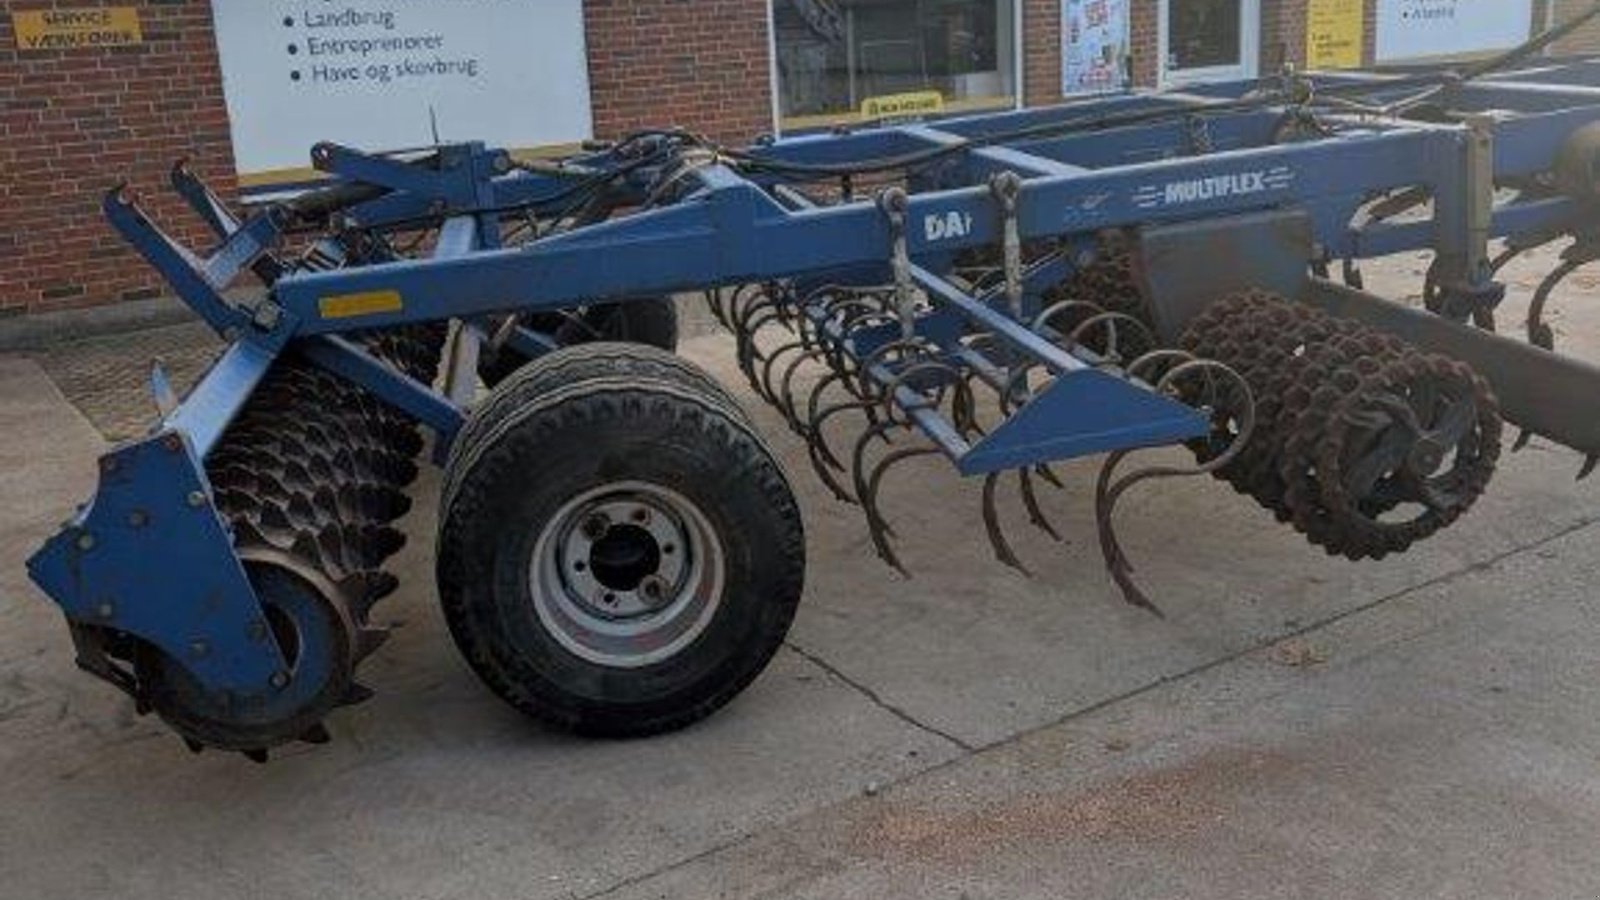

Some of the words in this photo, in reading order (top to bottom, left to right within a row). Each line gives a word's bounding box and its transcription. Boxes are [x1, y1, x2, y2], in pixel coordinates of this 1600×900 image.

[305, 10, 394, 30] Landbrug
[313, 65, 360, 83] Have
[365, 65, 391, 82] og
[397, 59, 478, 78] skovbrug
[1165, 172, 1265, 204] MULTIFLEX
